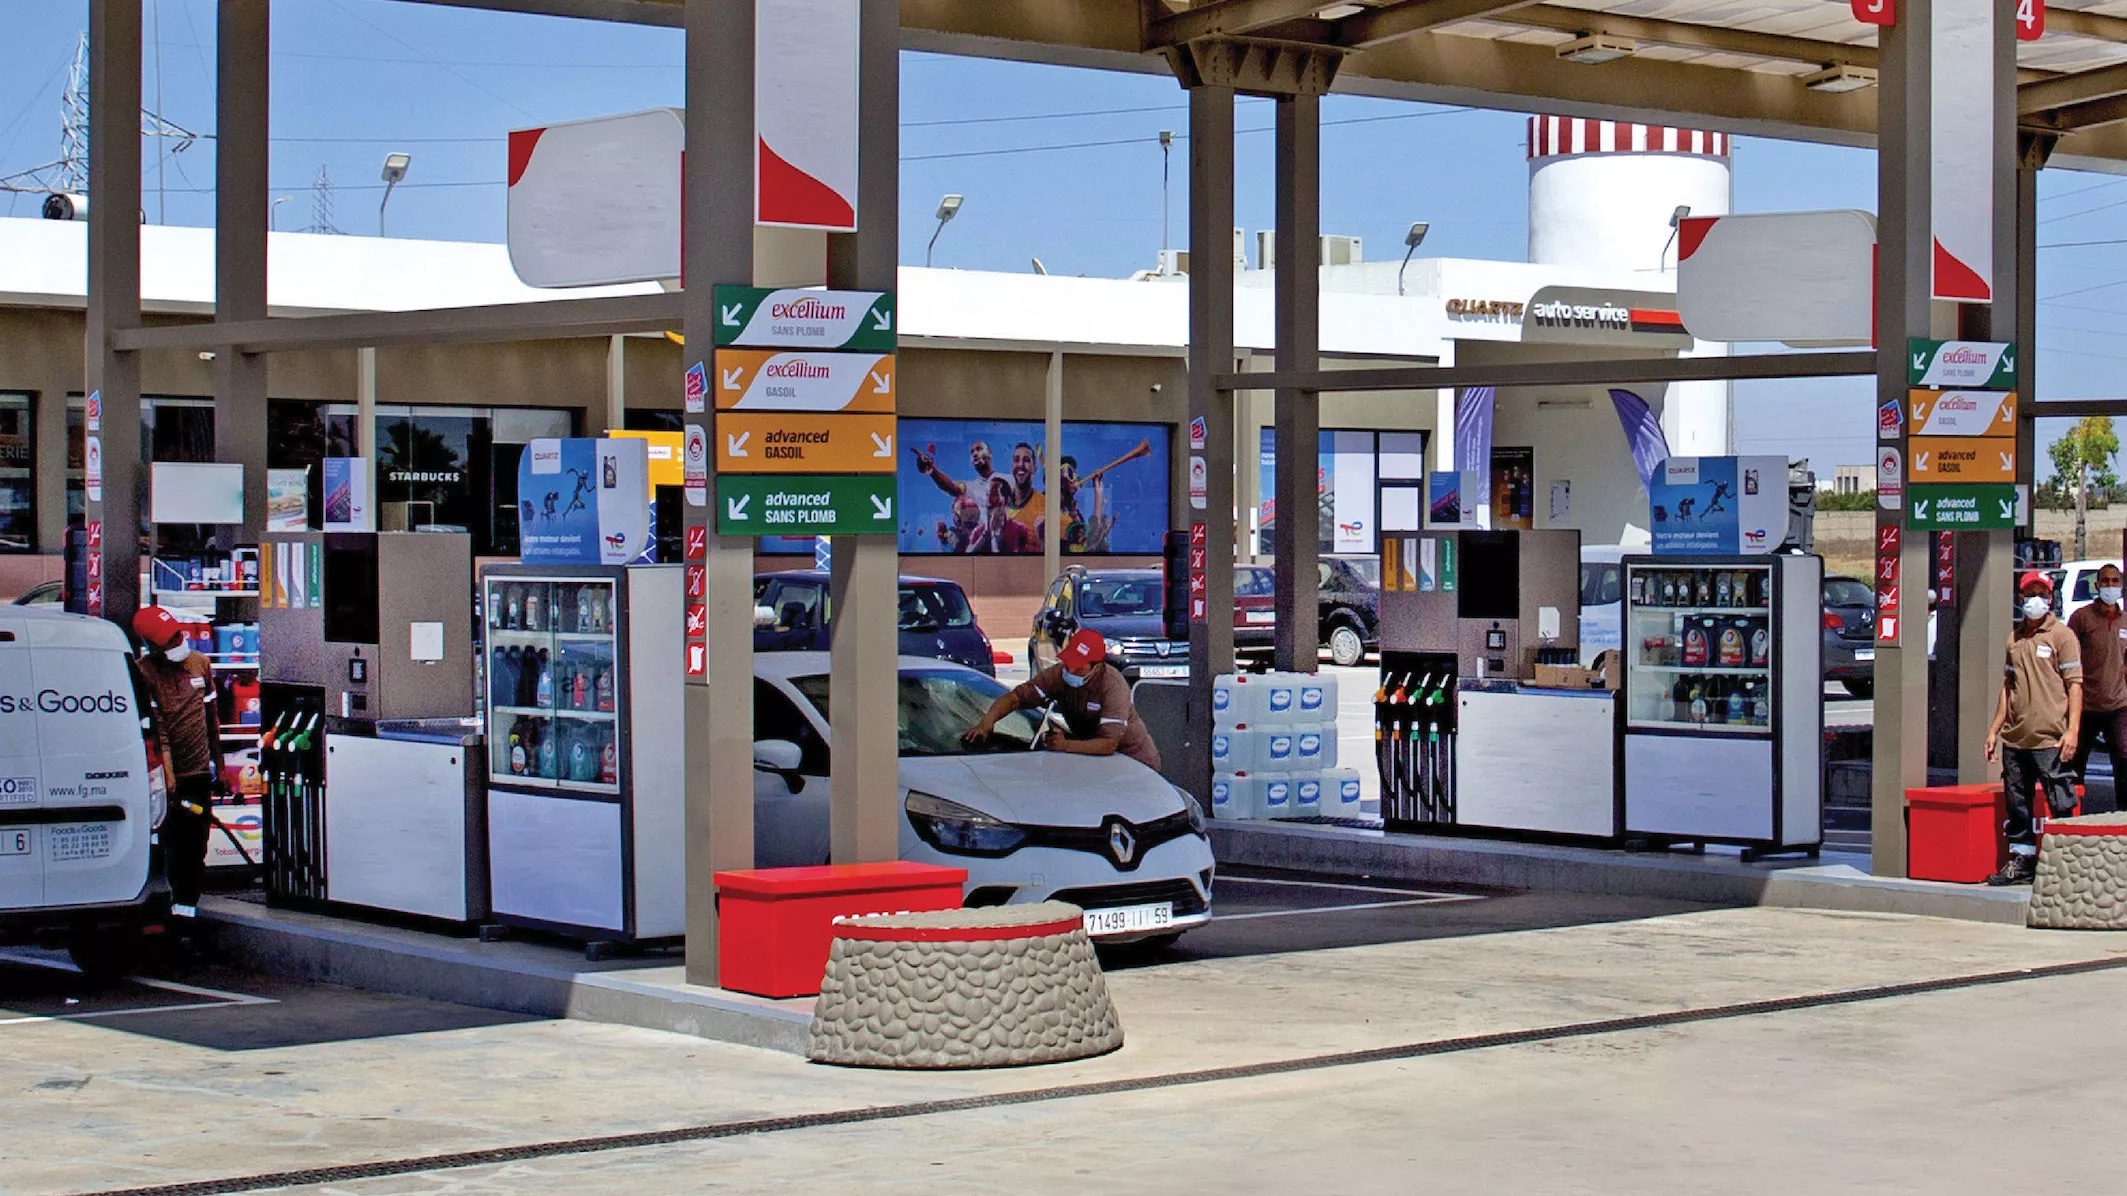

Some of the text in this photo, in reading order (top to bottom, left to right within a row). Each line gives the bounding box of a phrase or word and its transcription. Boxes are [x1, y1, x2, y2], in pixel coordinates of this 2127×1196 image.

[772, 298, 846, 320] excellium
[1445, 298, 1524, 316] QUARTZ
[1533, 301, 1629, 322] auto service
[771, 325, 825, 337] SANS PLOMB
[1942, 347, 1987, 365] excellium
[766, 360, 830, 379] excellium
[766, 386, 797, 398] GASOIL
[765, 430, 830, 444] advanced
[765, 446, 805, 459] GASOIL
[1937, 450, 1976, 460] advanced
[1937, 462, 1961, 473] GASOIL
[389, 471, 461, 483] STARBUCKS
[765, 492, 831, 506] advanced
[1936, 497, 1975, 508] advanced
[765, 509, 836, 524] SANS PLOMB
[1936, 511, 1979, 522] SANS PLOMB
[19, 697, 34, 711] &
[38, 689, 128, 713] Goods
[49, 784, 107, 798] www.fg.ma
[16, 833, 25, 851] 6
[1089, 907, 1168, 931] 71499 59
